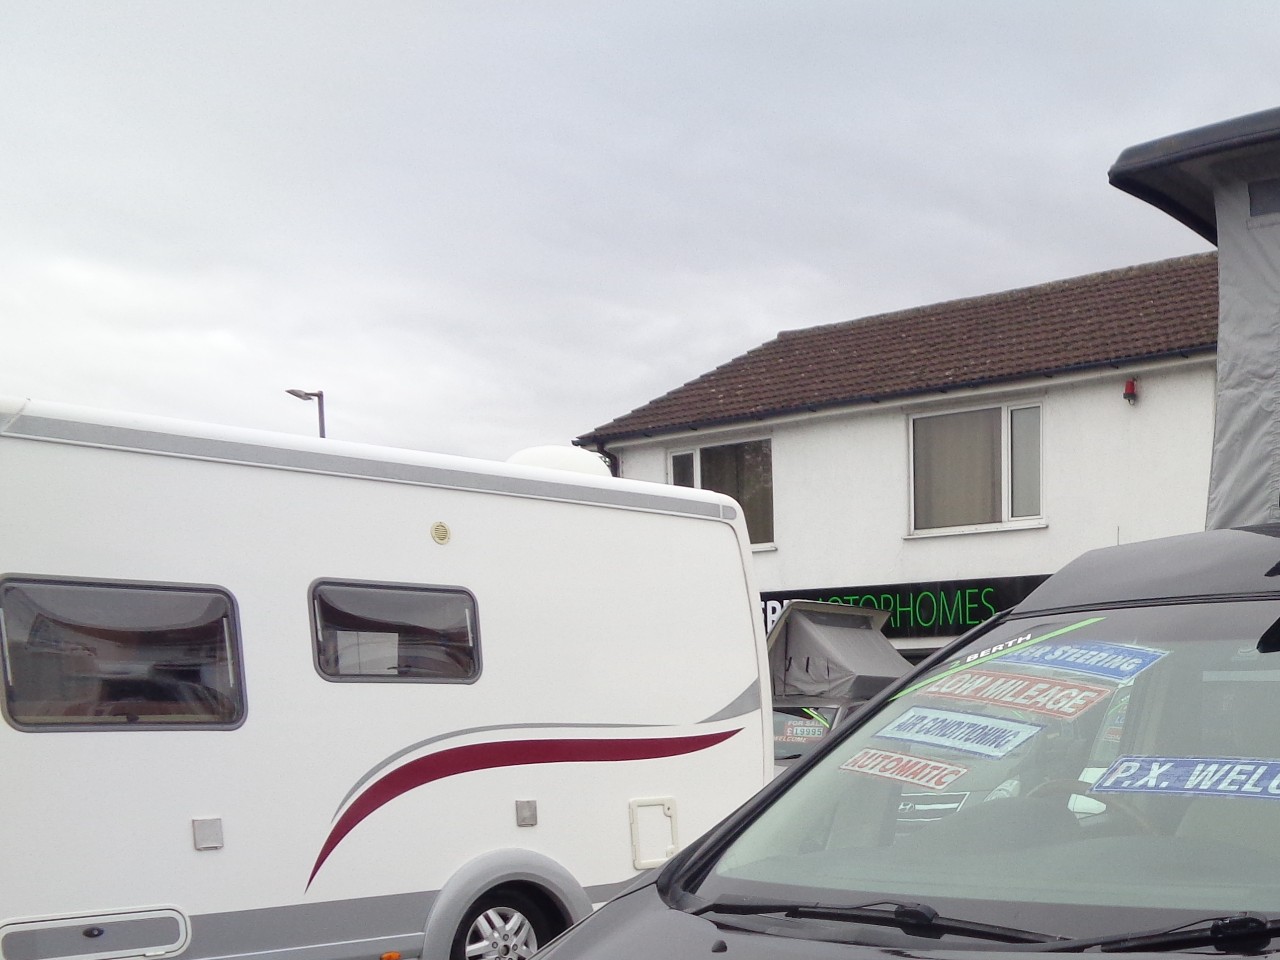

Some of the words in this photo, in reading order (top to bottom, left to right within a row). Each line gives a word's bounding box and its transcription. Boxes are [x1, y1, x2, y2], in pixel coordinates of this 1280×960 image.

[966, 634, 1031, 662] BERTH
[1044, 645, 1143, 671] STEERING
[926, 674, 993, 696] LOW
[976, 678, 1098, 713] MILEAGE
[892, 714, 923, 732] AIR
[916, 717, 1021, 749] CONDITIONING
[845, 752, 960, 786] AUTOMATIC
[1103, 762, 1174, 788] P.X.
